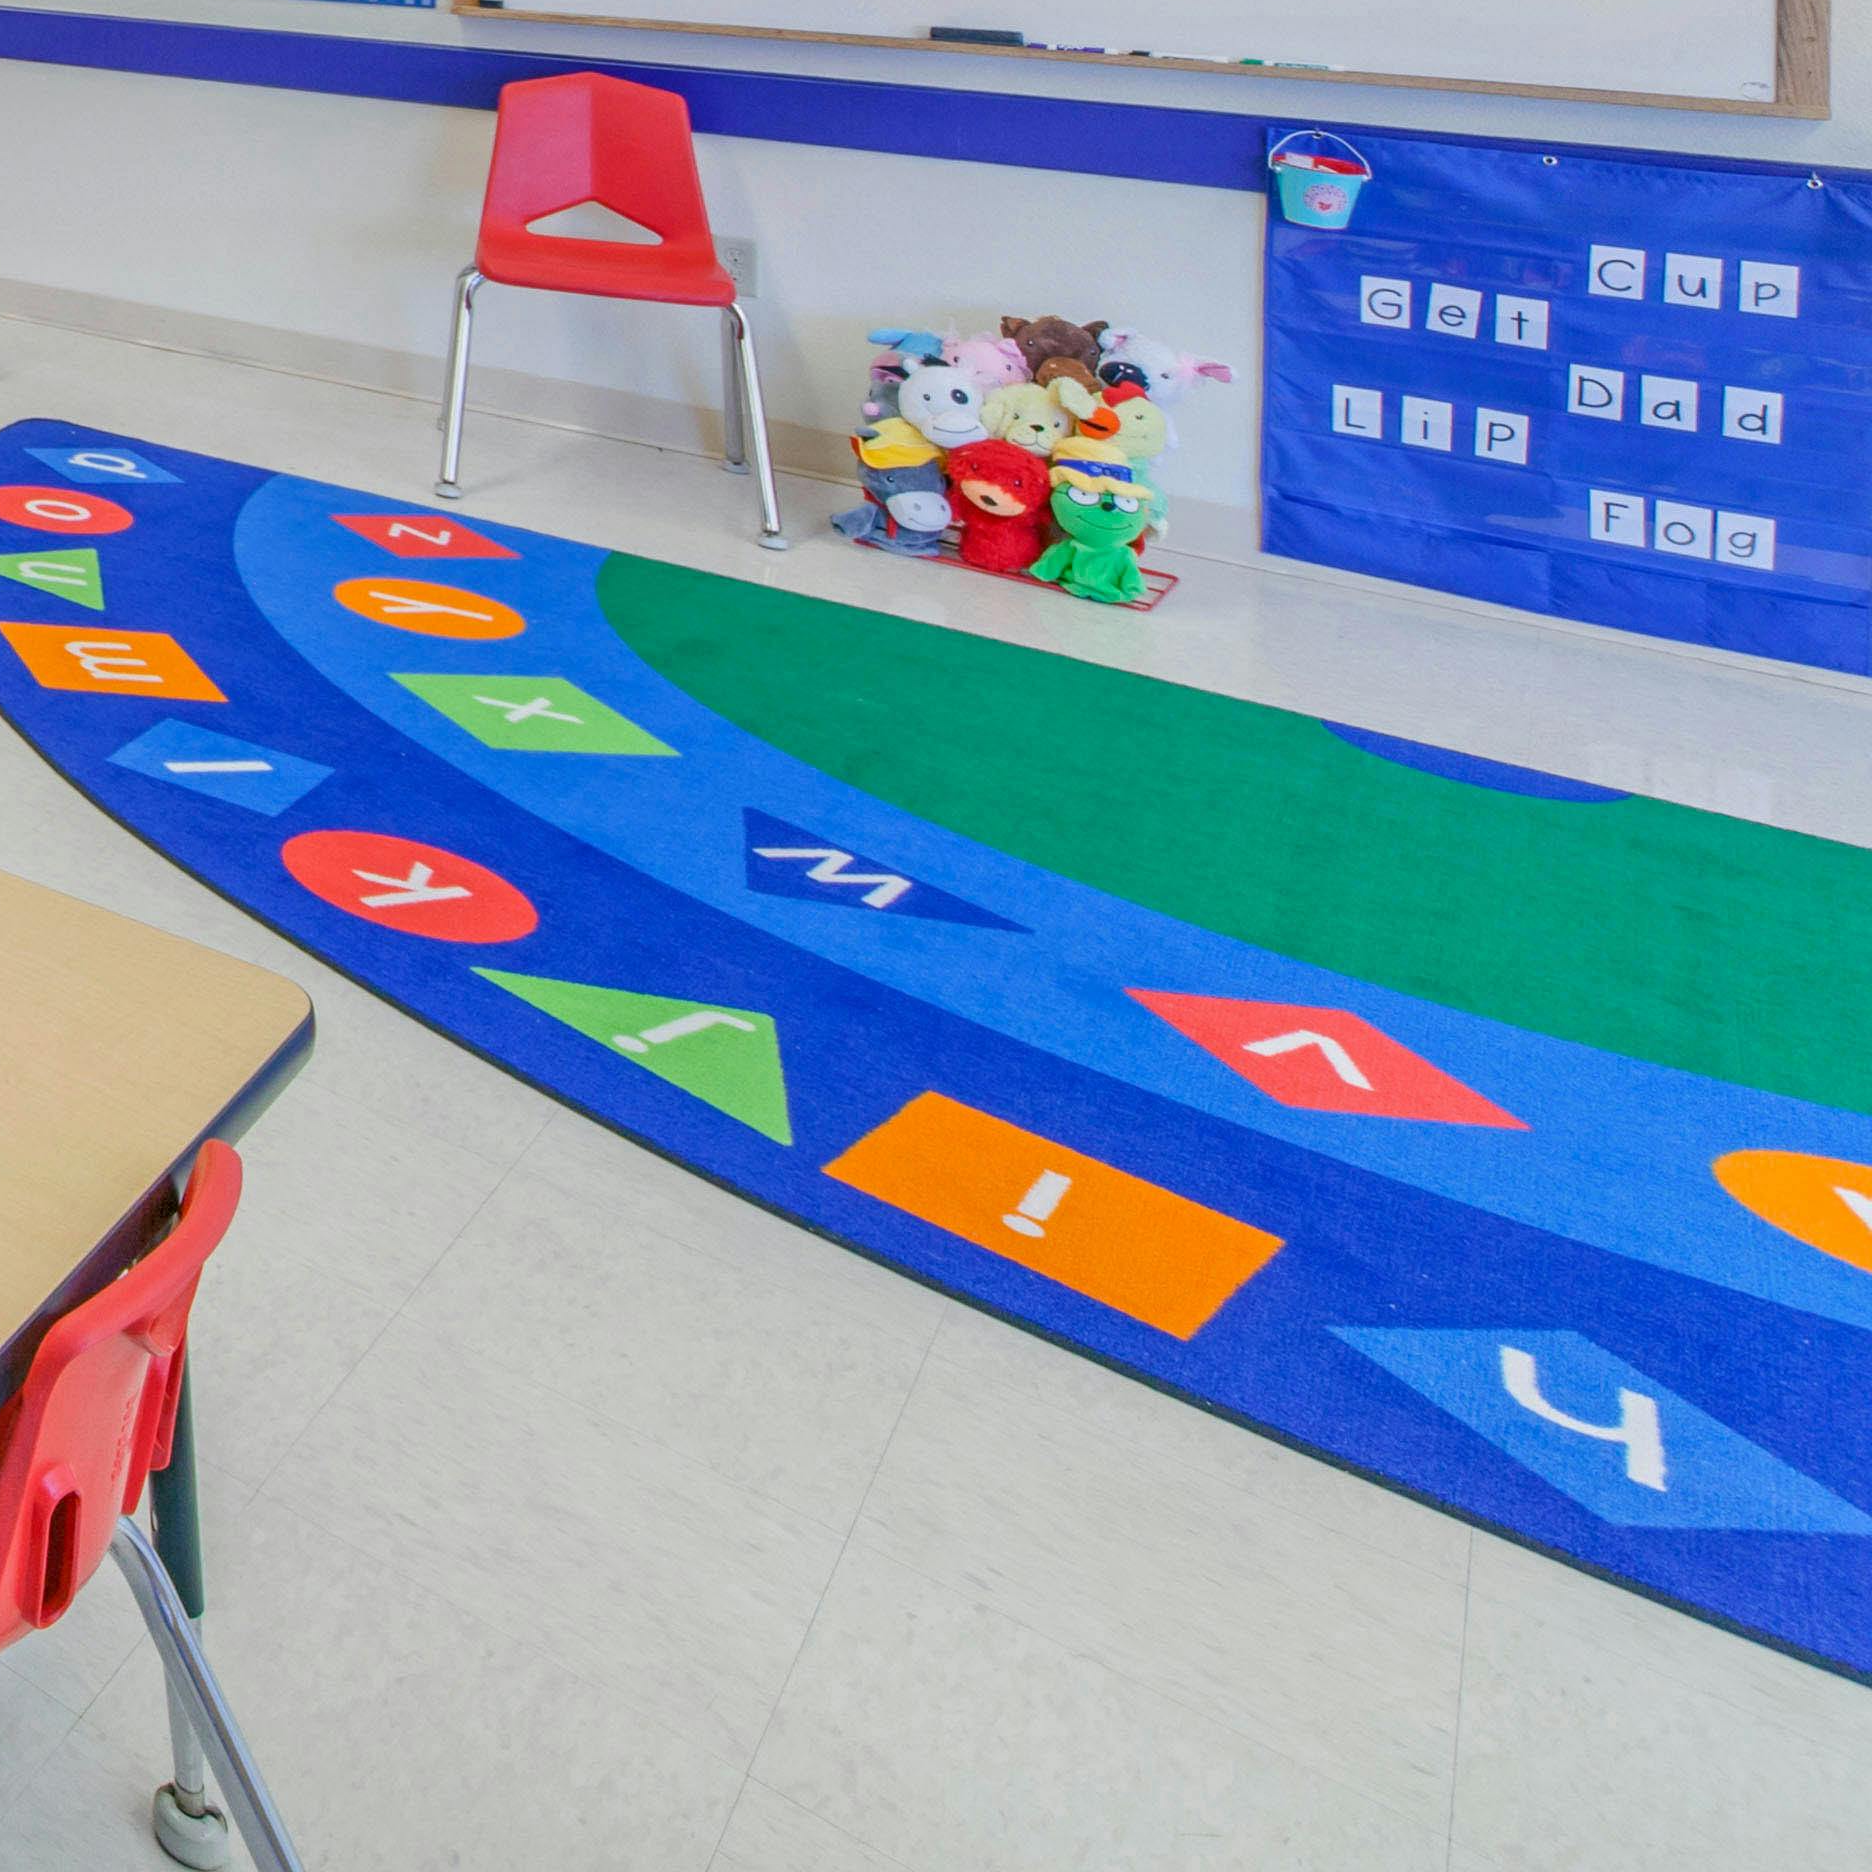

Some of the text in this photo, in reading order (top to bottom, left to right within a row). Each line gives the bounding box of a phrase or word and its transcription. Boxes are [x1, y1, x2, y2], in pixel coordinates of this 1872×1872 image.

[1597, 258, 1780, 307] Cup
[1367, 288, 1530, 341] Get
[1345, 397, 1515, 453] Lip
[1577, 375, 1769, 436] Dad
[24, 499, 92, 522] o
[1603, 501, 1757, 559] Fog
[66, 641, 162, 683] m
[610, 1008, 759, 1056] j
[1500, 1346, 1668, 1493] h
